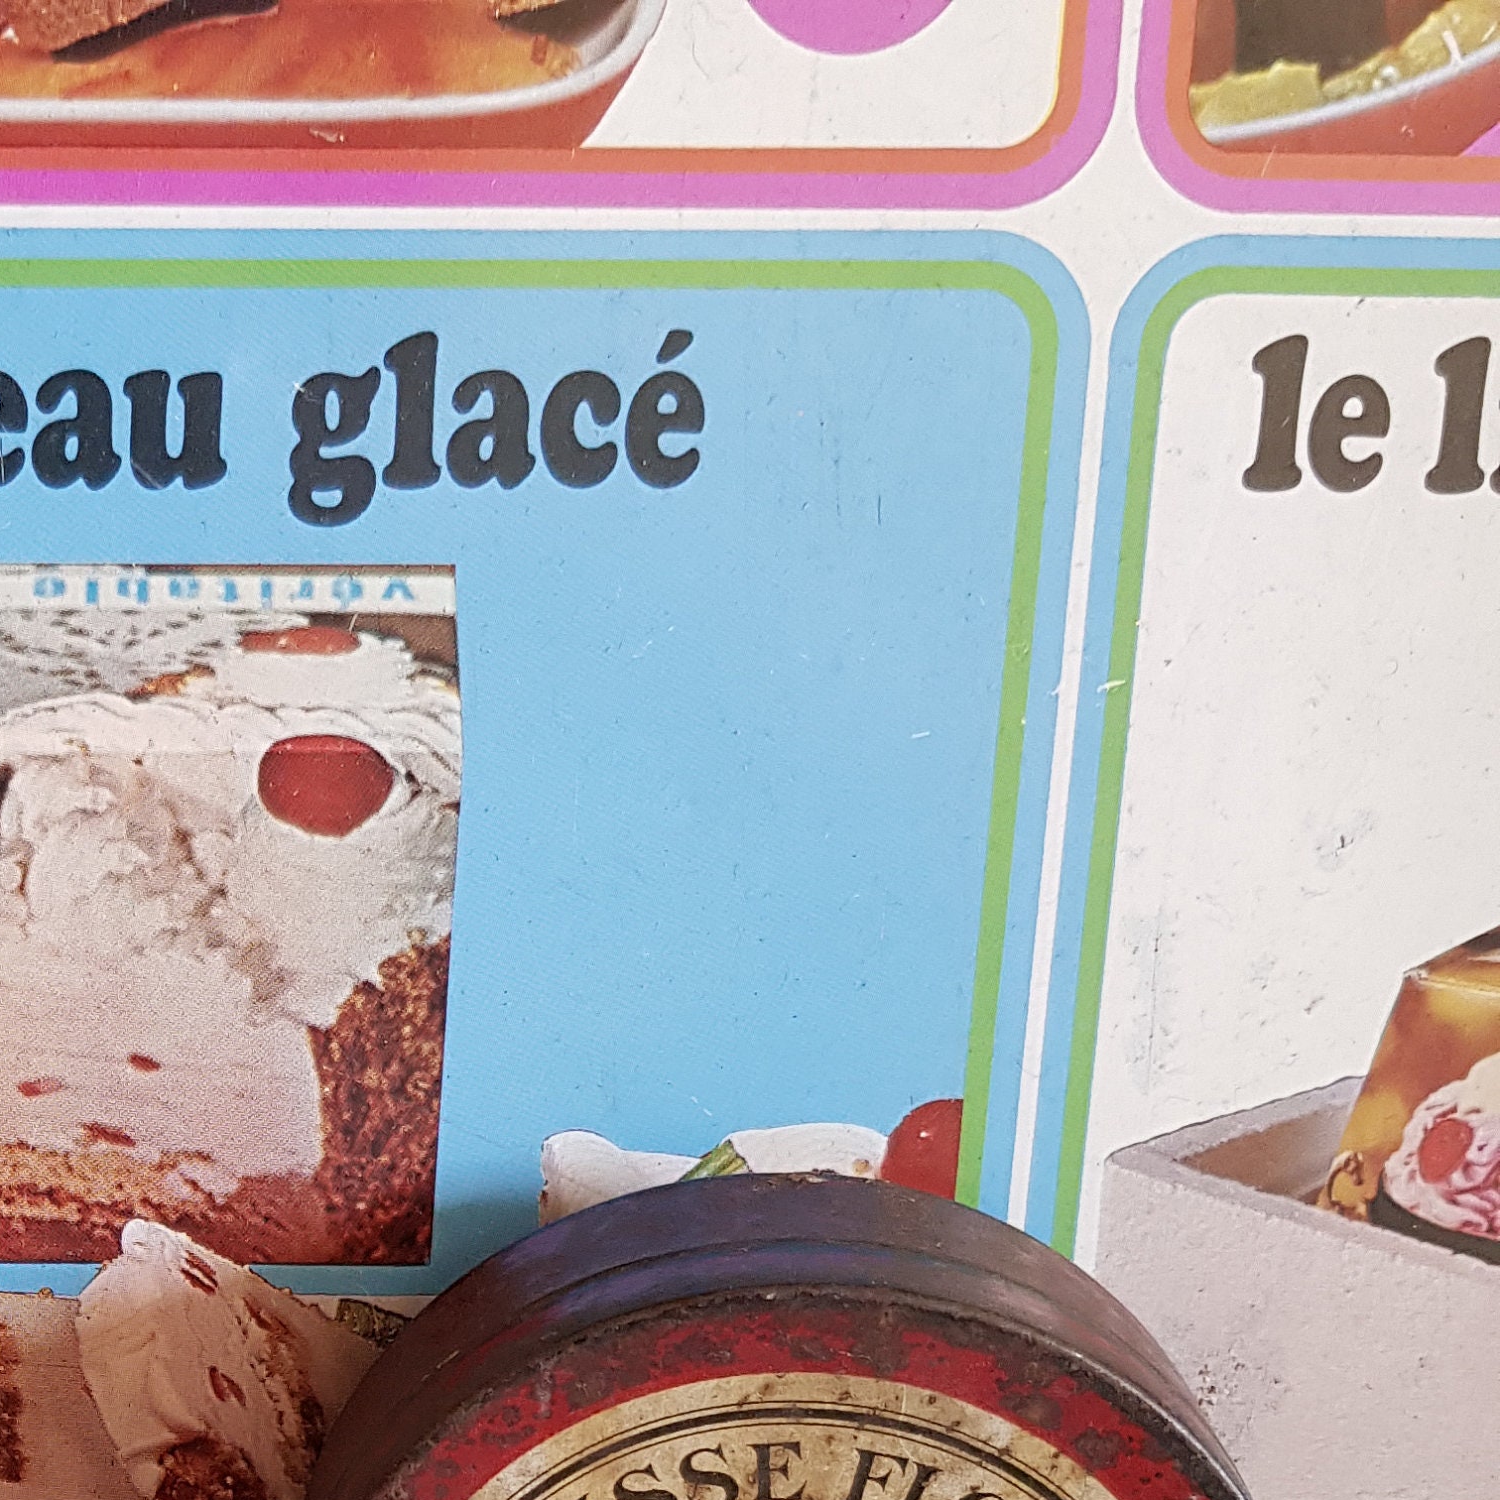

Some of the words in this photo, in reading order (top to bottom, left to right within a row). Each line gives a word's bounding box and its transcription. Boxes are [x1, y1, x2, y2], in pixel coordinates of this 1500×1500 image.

[287, 327, 706, 527] glacé
[1241, 333, 1392, 493] le
[1423, 335, 1500, 496] l
